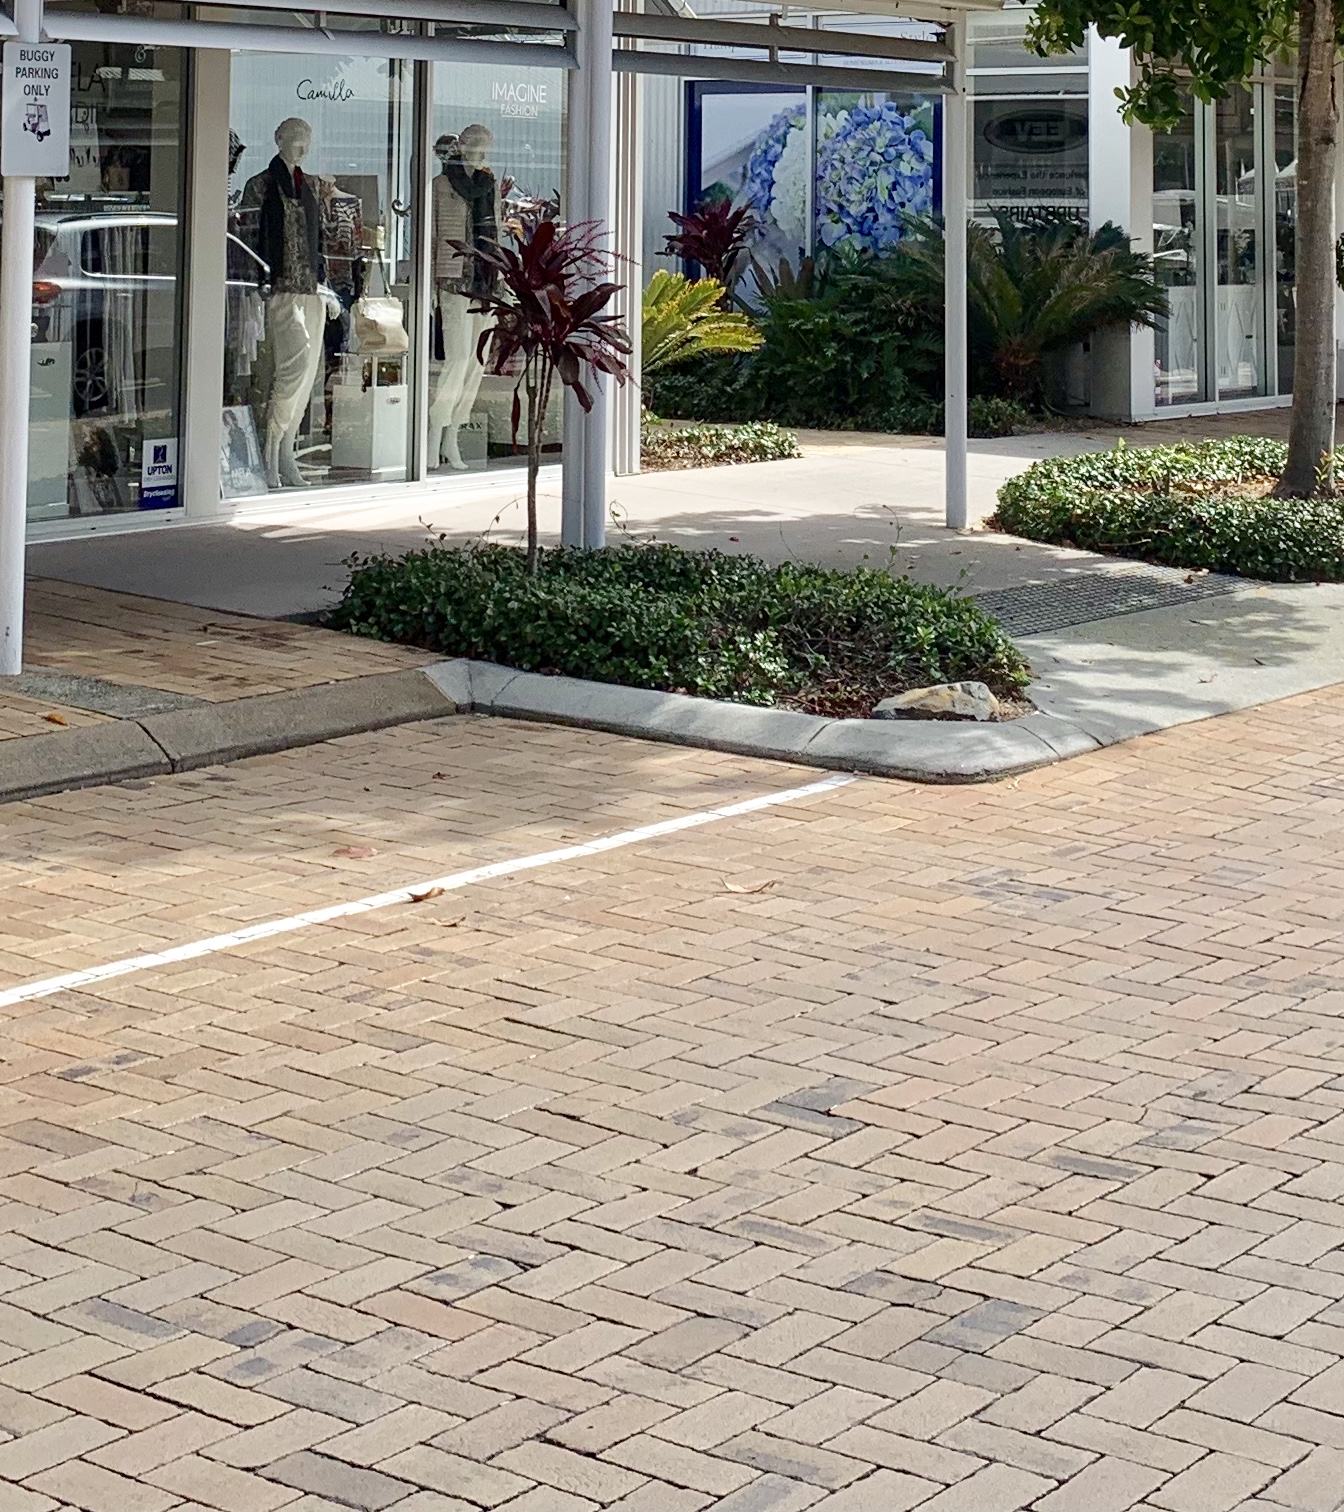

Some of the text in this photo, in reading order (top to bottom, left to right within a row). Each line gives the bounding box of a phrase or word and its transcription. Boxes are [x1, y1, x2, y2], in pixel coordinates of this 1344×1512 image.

[19, 49, 56, 62] BUGGY
[15, 66, 59, 80] PARKING
[23, 84, 51, 97] ONLY
[296, 78, 355, 102] Camilla
[491, 81, 548, 104] IMAGINE
[500, 103, 538, 117] FASHION
[147, 464, 173, 476] UPTON
